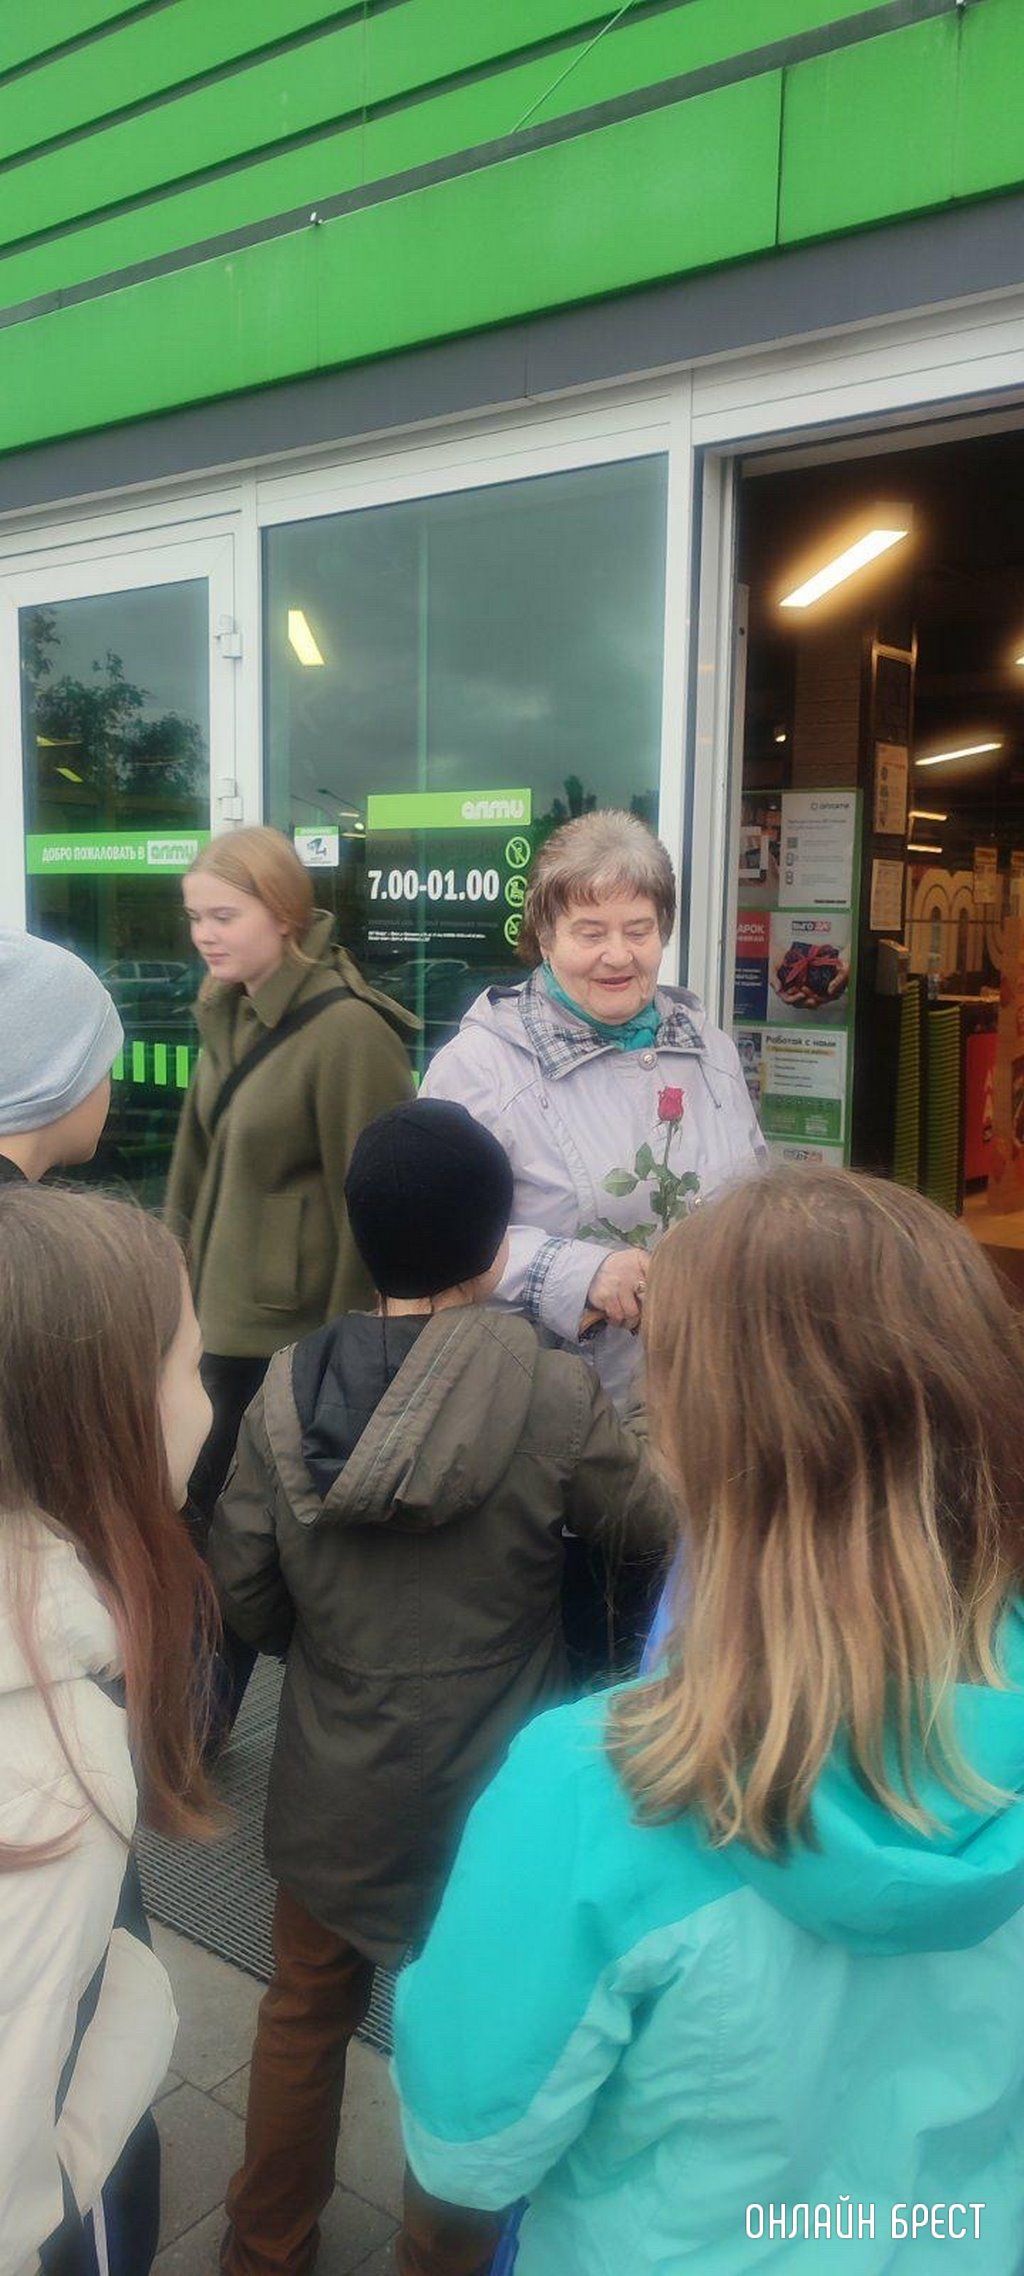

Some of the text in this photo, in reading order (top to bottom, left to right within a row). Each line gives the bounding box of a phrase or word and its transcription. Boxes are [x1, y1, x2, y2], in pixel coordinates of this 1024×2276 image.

[43, 847, 72, 862] ДОБРО
[74, 846, 136, 861] ПОЖАЛОВАТЬ
[137, 846, 145, 860] В
[368, 869, 500, 901] 7.00-01.00
[766, 1035, 802, 1044] Работай
